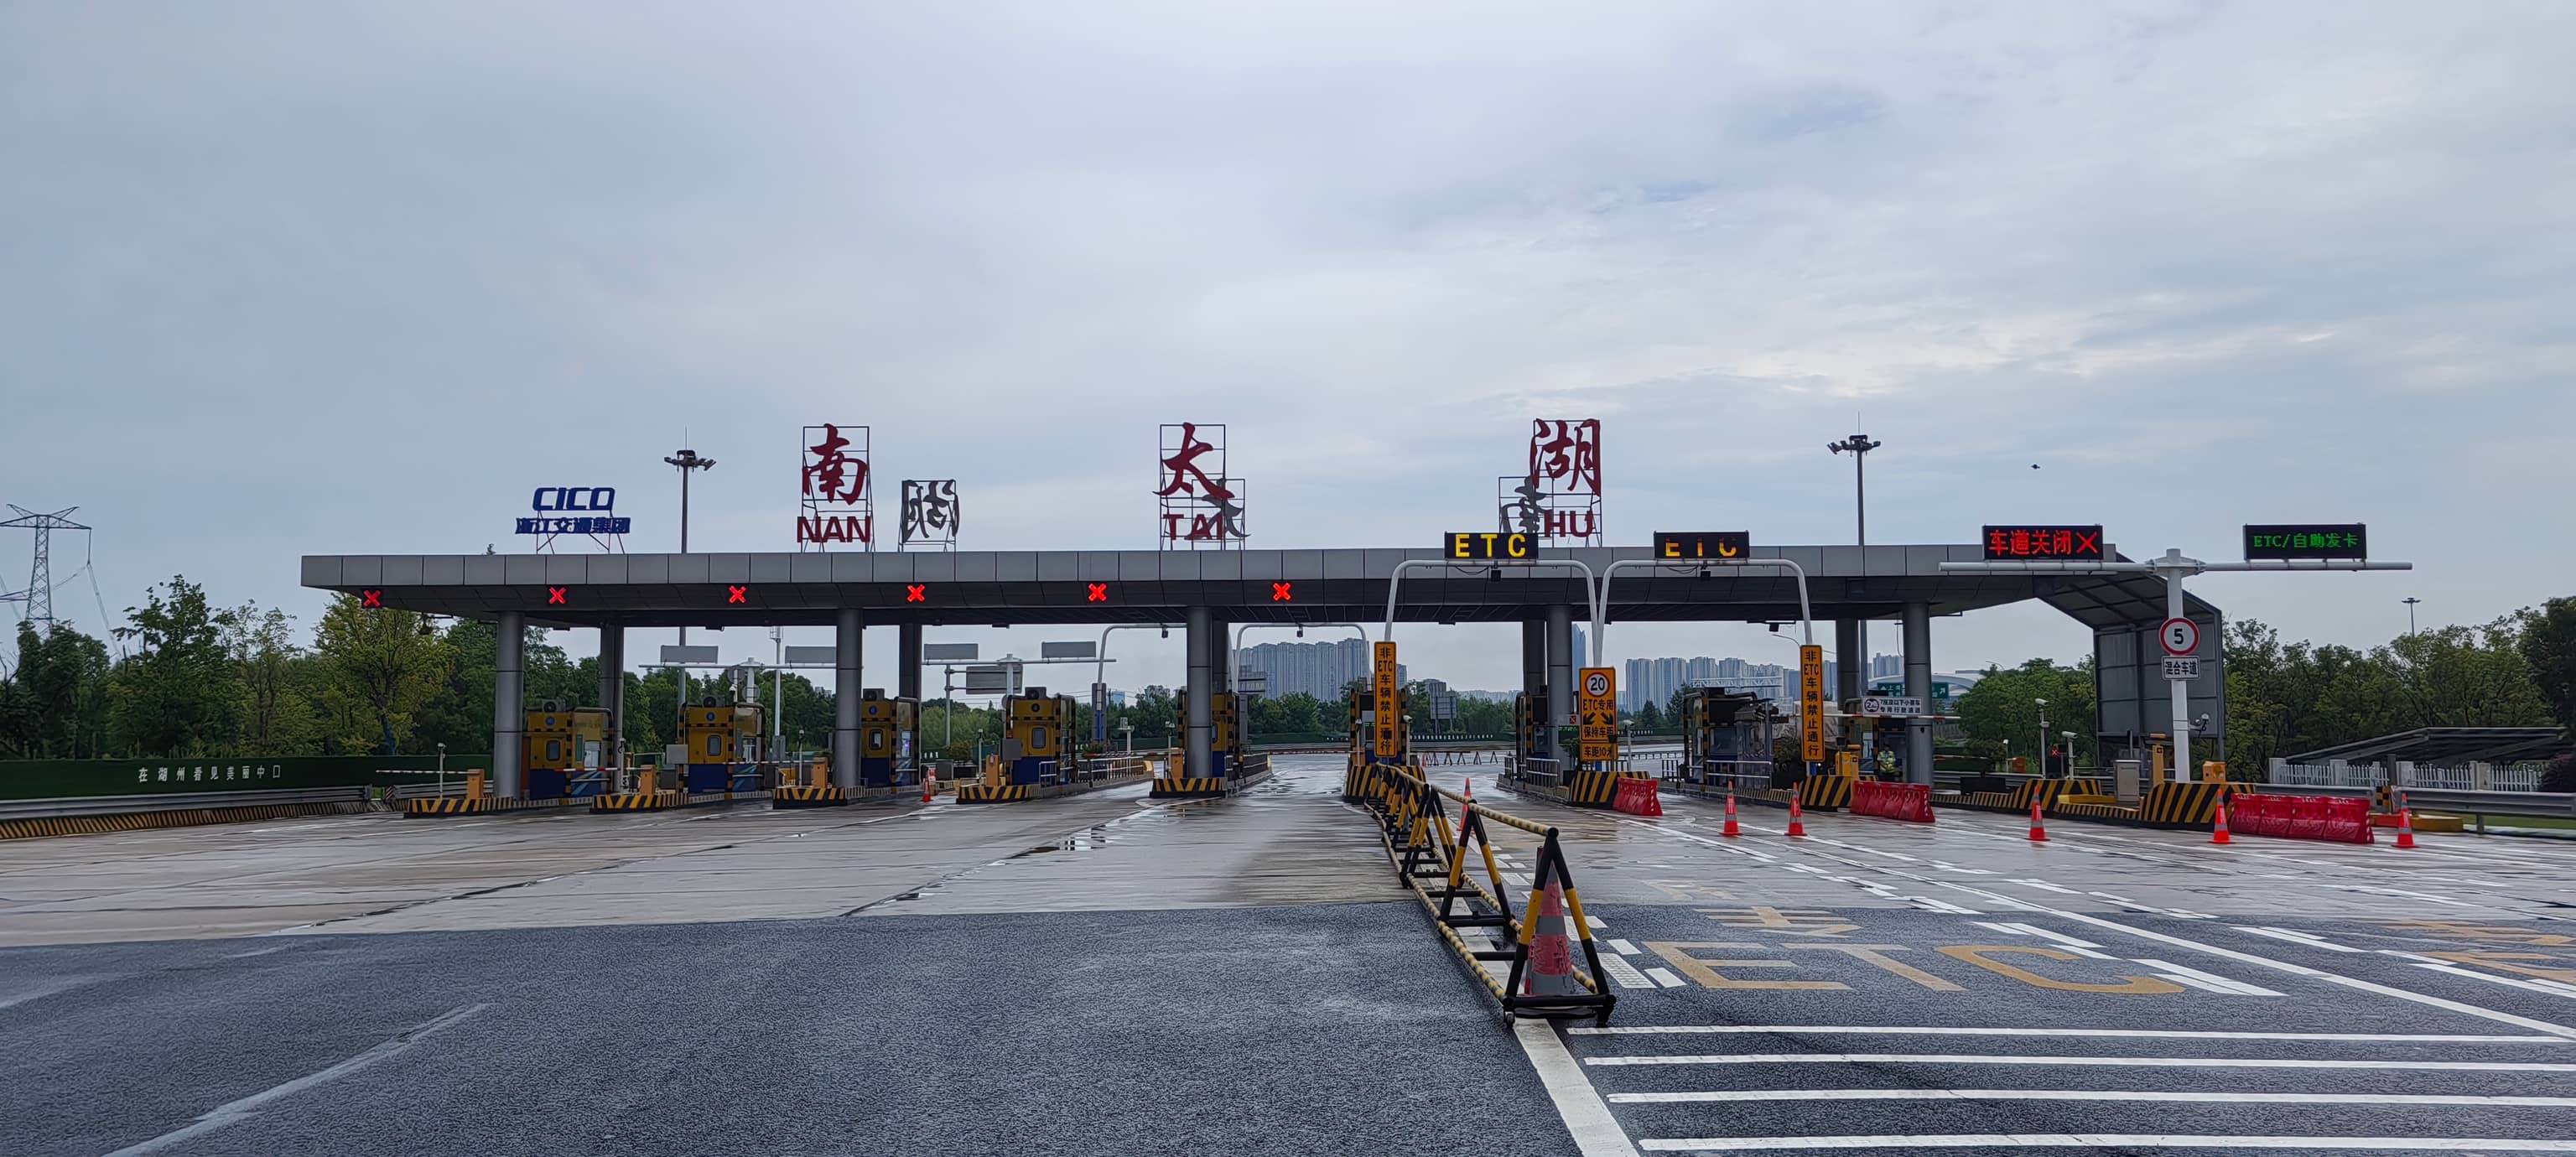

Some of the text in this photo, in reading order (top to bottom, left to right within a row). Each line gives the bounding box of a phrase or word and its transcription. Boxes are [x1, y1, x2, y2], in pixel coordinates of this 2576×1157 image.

[802, 418, 1601, 506] 南 太 湖
[532, 487, 615, 511] CICO
[797, 511, 1593, 542] NAN TAI HU
[1455, 533, 1526, 558] ETC
[1988, 530, 2072, 556] 车道关闭
[2254, 532, 2359, 547] ETC/自助发卡
[2174, 628, 2184, 645] 5
[2165, 661, 2197, 675] 混合车道
[1590, 677, 1605, 691] 20
[1583, 699, 1613, 711] ETC专用
[1642, 942, 2186, 994] ETC
